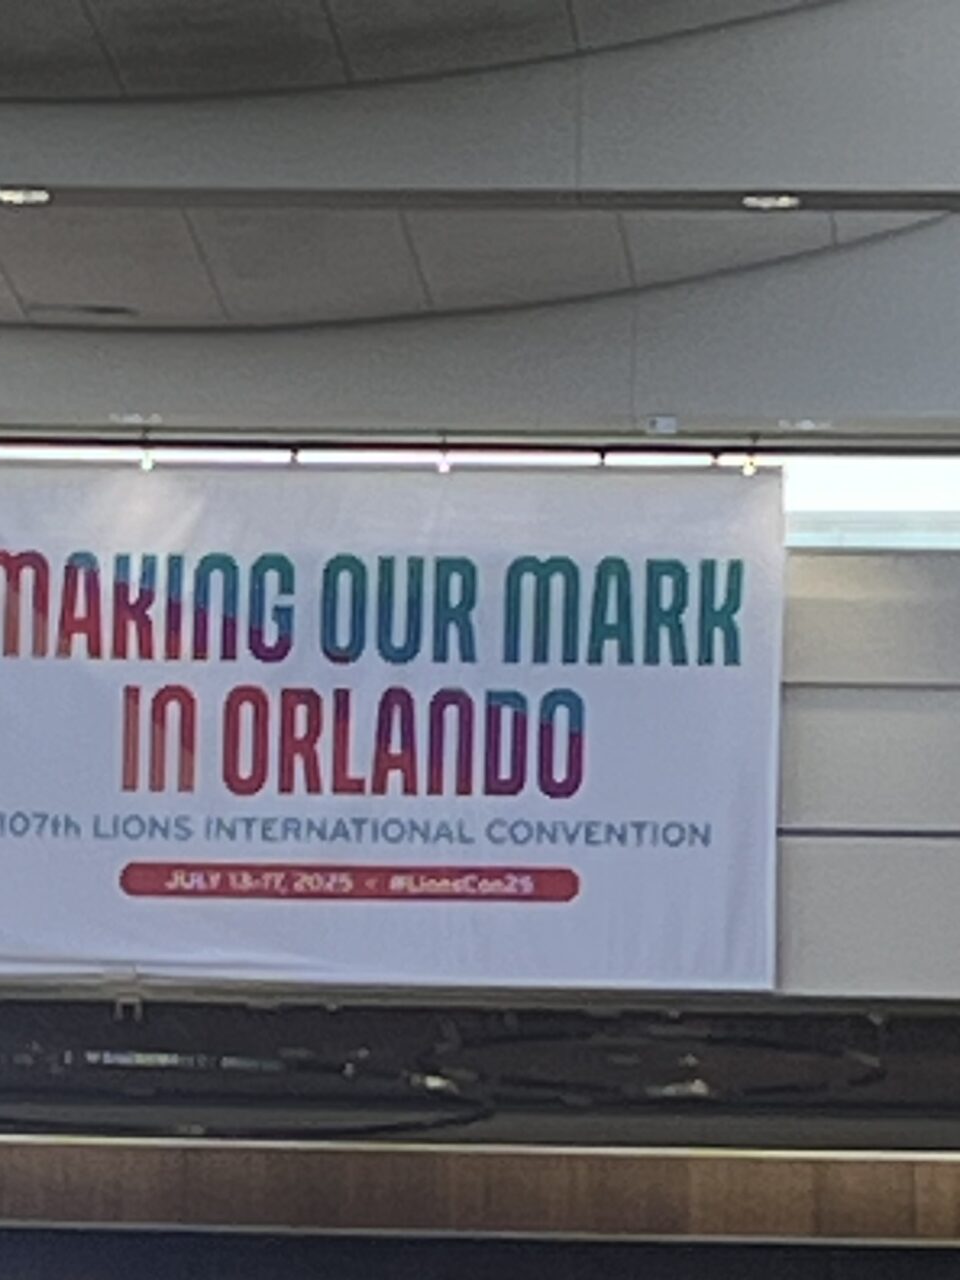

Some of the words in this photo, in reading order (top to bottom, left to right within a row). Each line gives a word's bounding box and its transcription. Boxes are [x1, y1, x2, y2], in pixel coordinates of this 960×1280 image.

[319, 552, 478, 665] OUR
[502, 555, 745, 667] MARK
[120, 684, 197, 793] IN
[222, 684, 586, 799] ORLANDO
[93, 813, 194, 842] LIONS
[205, 816, 475, 846] INTERNATIONAL
[484, 818, 713, 848] CONVENTION
[165, 869, 221, 890] JULY
[293, 872, 354, 893] 2025
